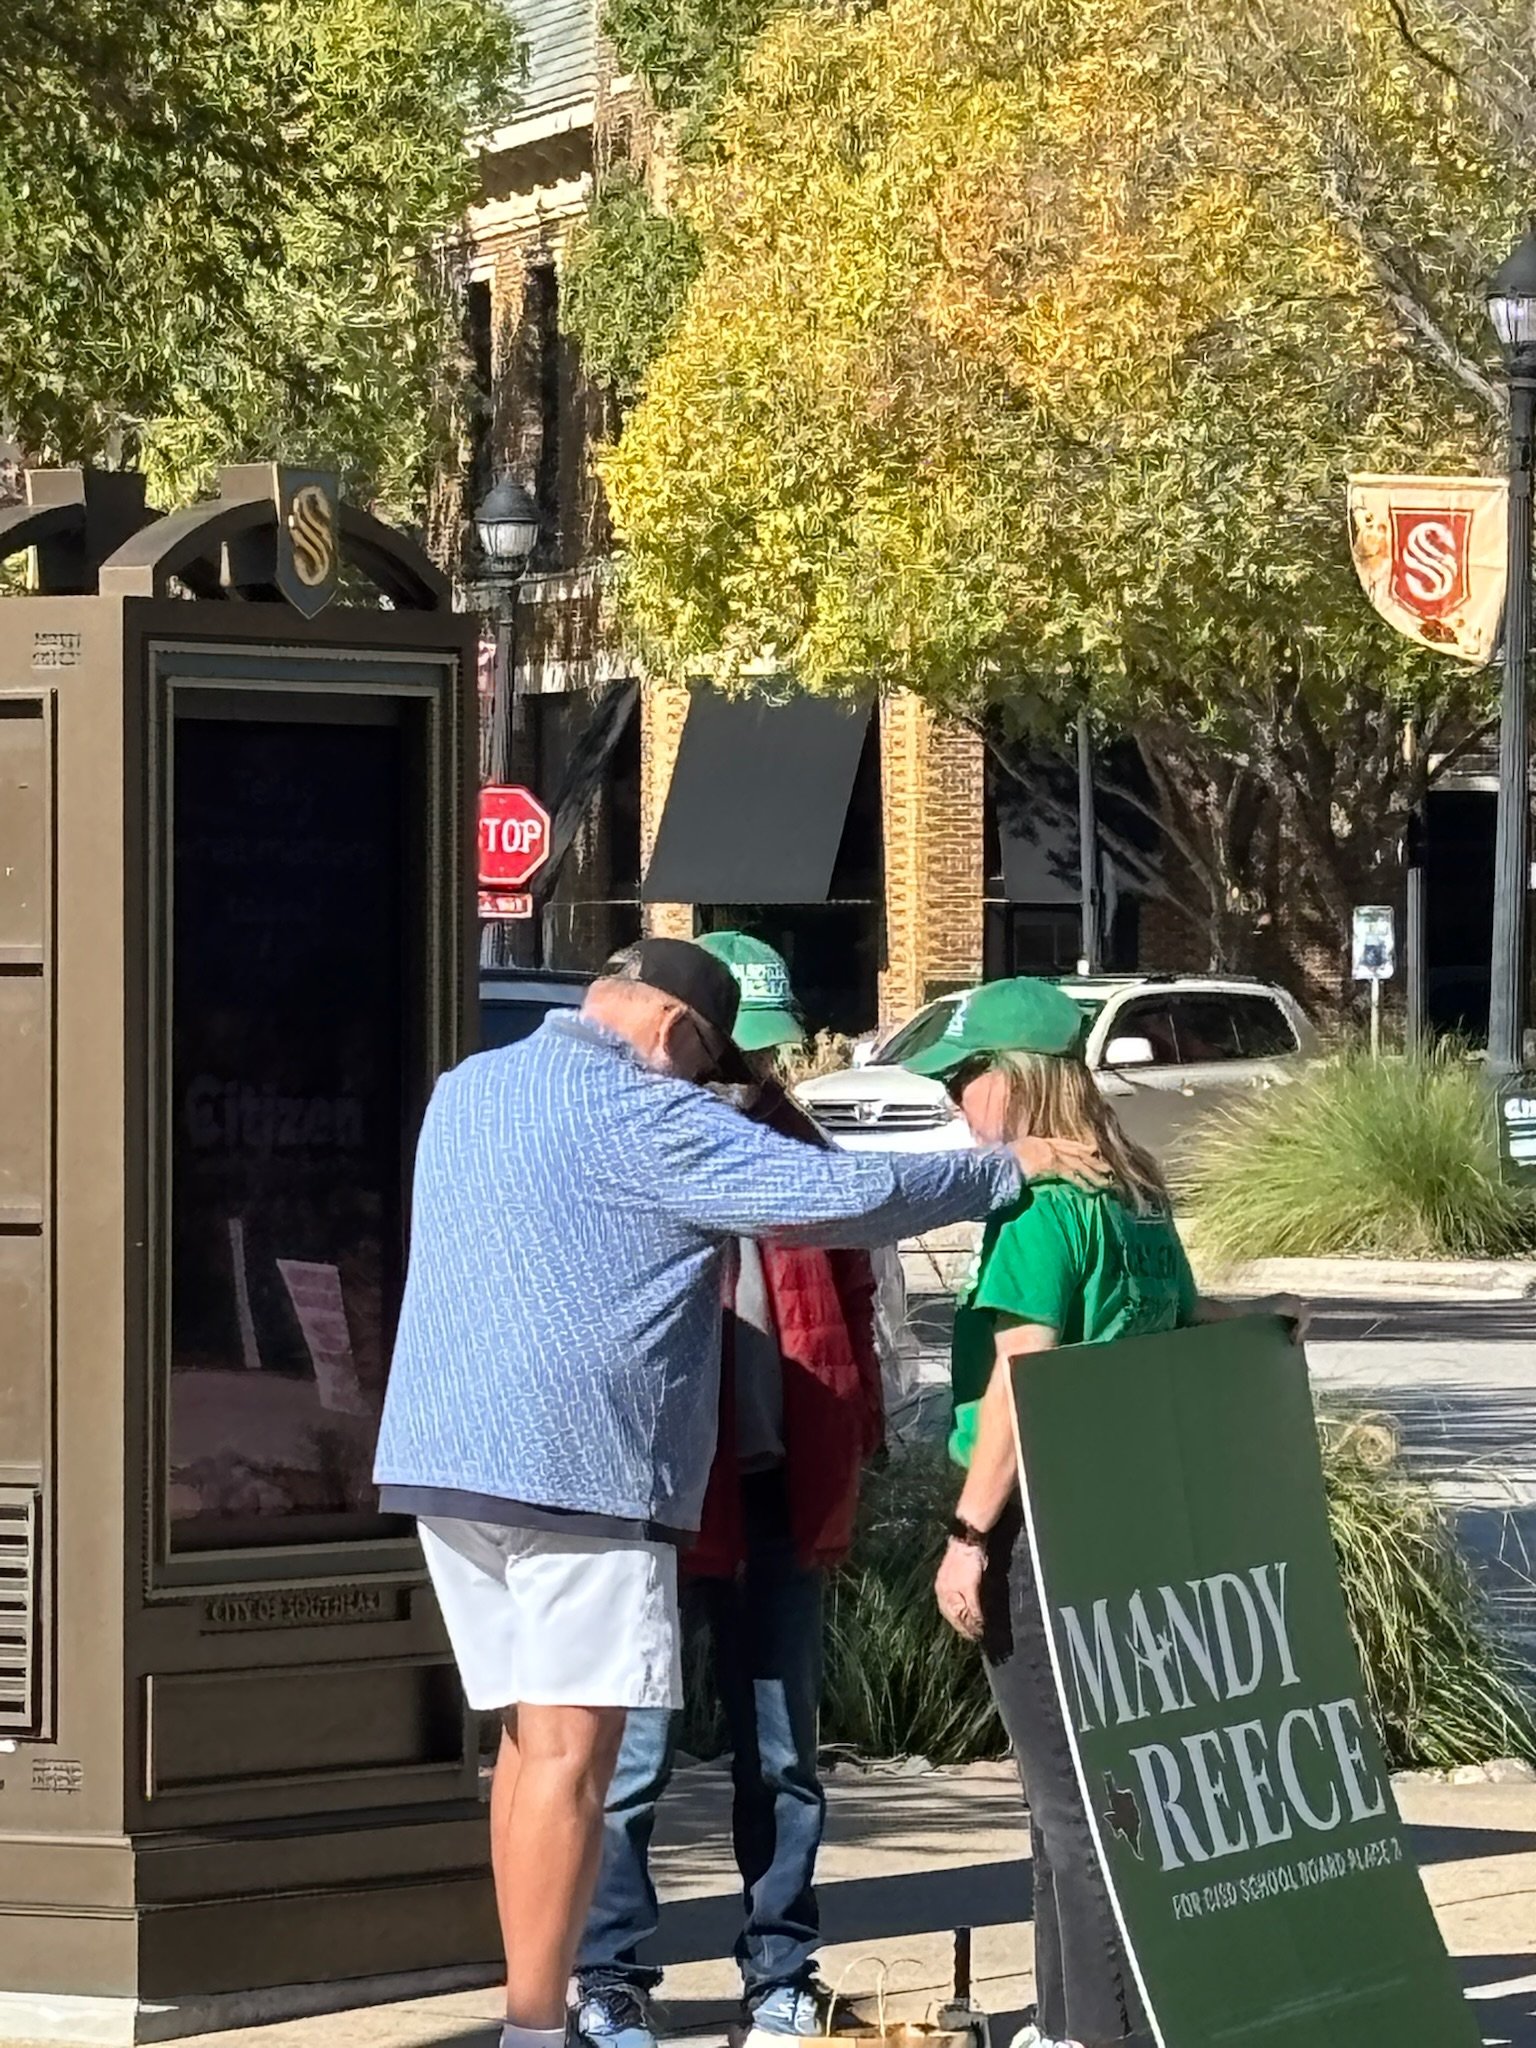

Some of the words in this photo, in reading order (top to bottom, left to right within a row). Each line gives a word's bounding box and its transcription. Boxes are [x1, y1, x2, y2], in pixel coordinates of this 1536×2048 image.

[479, 817, 542, 854] TOP
[1059, 1561, 1301, 1734] MANDY
[1128, 1697, 1387, 1873] REECE
[1172, 1890, 1203, 1920] FOR
[1240, 1865, 1300, 1903] SCHOOL
[1297, 1851, 1347, 1887] BOARD
[1346, 1838, 1391, 1873] PLACE
